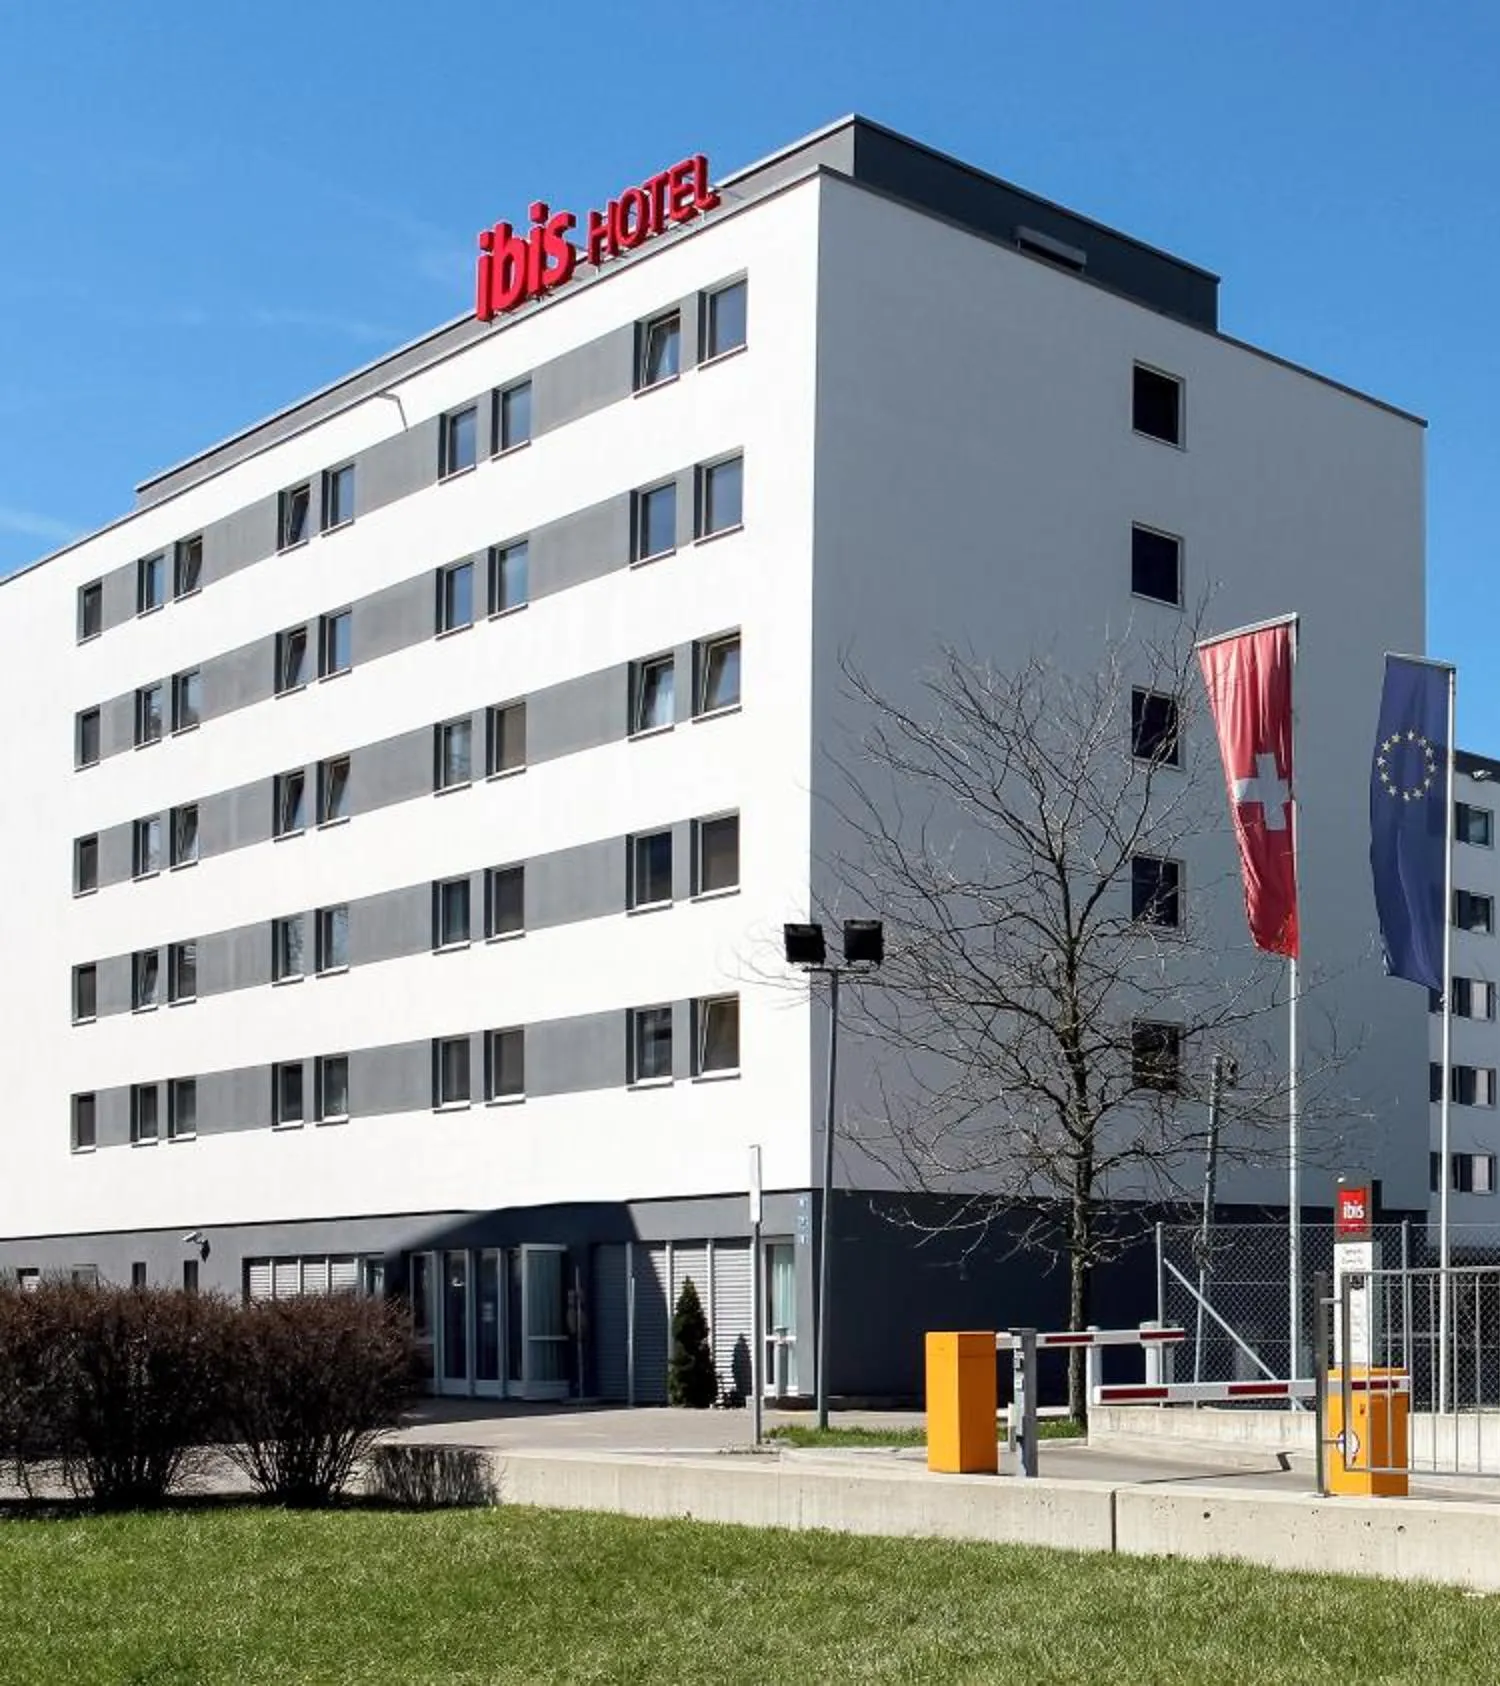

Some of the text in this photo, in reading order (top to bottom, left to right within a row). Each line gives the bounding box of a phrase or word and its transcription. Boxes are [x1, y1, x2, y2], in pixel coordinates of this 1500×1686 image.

[476, 154, 721, 321] ibis HOTEL
[1343, 1200, 1365, 1219] ibis
